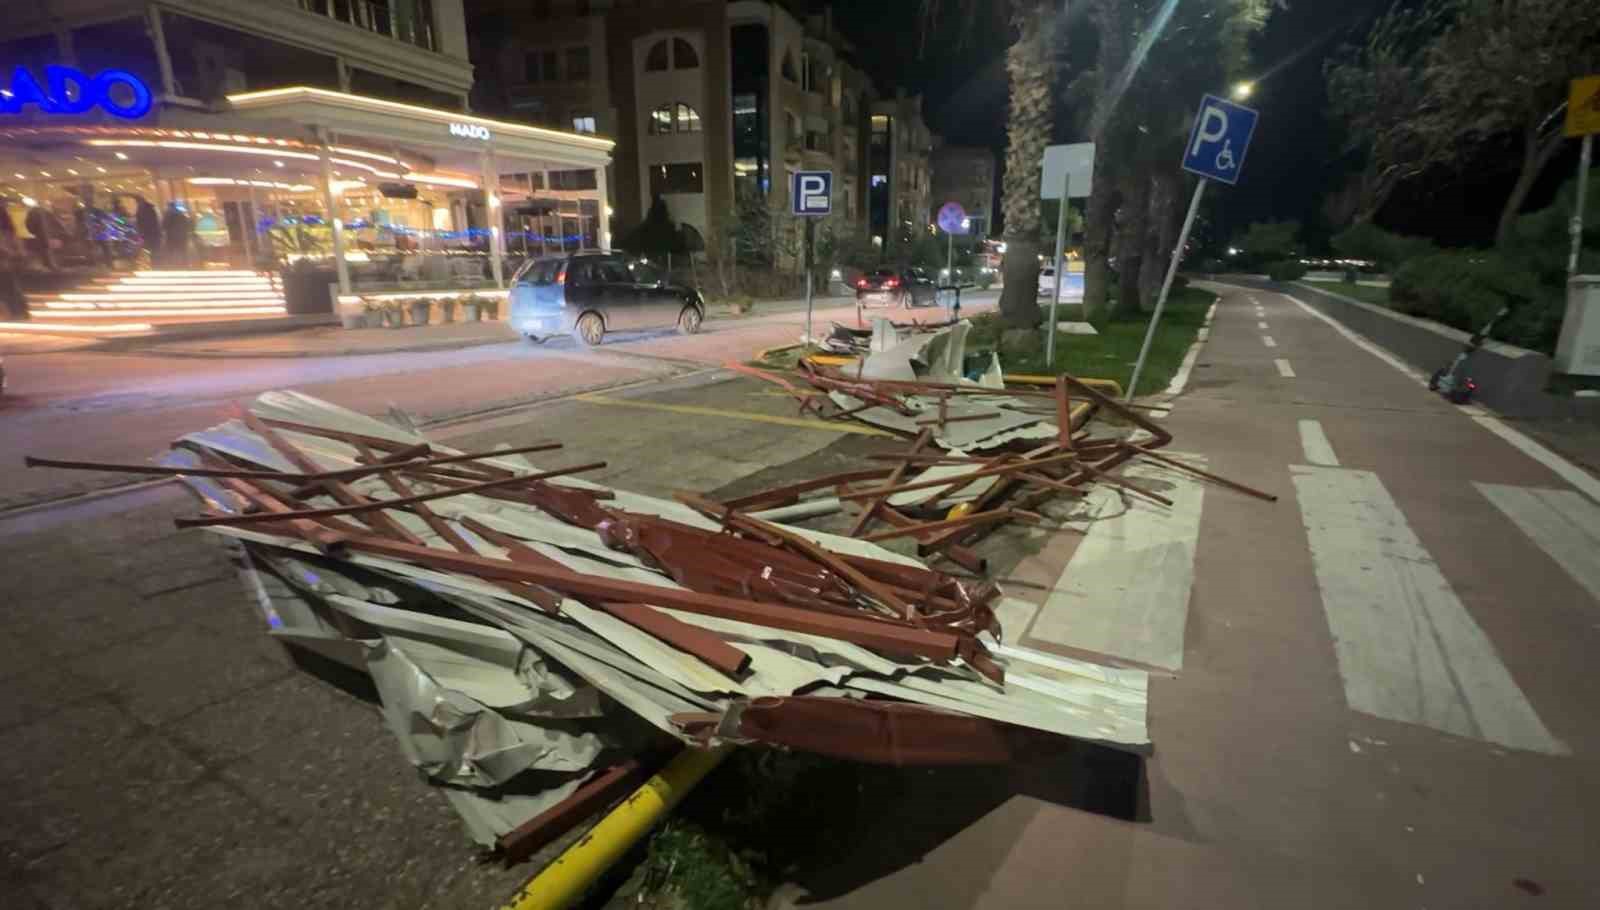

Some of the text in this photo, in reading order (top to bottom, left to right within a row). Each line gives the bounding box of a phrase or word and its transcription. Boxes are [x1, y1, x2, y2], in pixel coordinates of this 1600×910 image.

[0, 64, 152, 119] ADO
[449, 123, 490, 140] MADO
[1192, 106, 1228, 156] P
[800, 175, 825, 210] P
